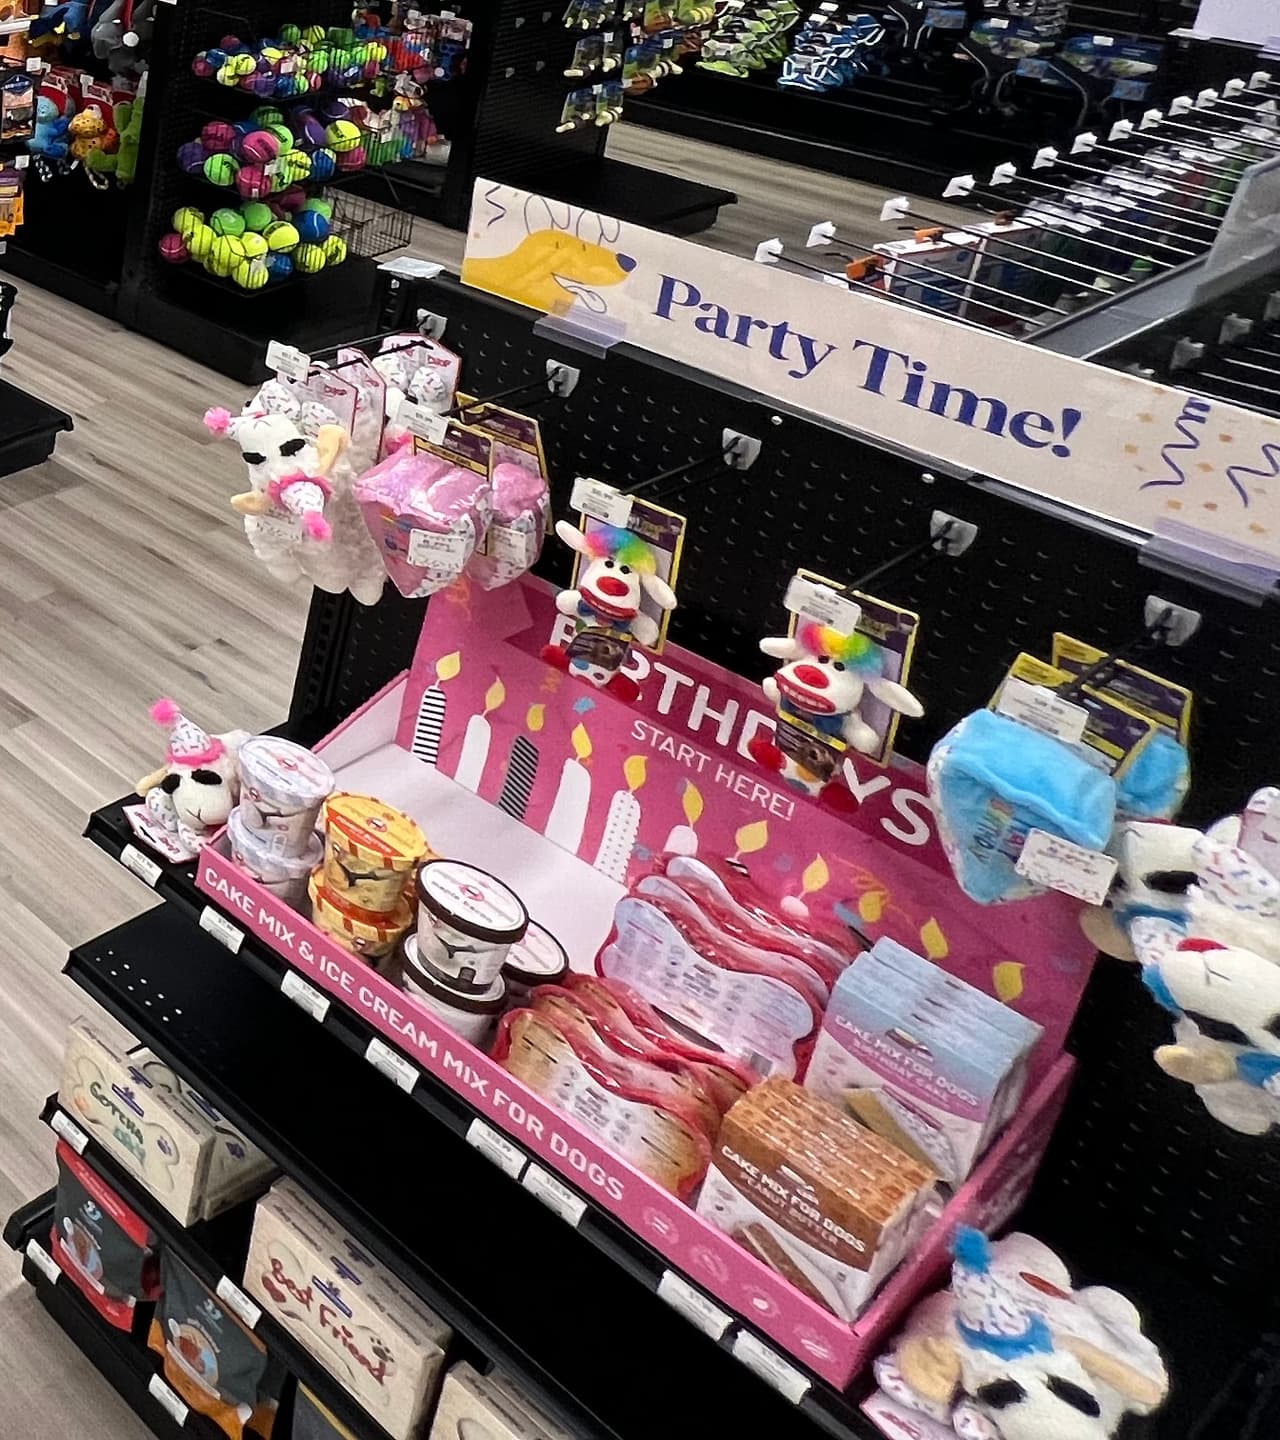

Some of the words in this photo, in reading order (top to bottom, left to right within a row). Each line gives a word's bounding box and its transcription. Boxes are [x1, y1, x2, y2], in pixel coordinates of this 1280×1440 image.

[654, 272, 838, 379] Party
[853, 338, 1083, 459] Time!
[549, 613, 932, 847] BRTHDYS
[631, 719, 711, 773] START
[715, 762, 796, 822] HERE!
[204, 867, 255, 917] CAKE
[258, 908, 296, 950] MIX
[298, 940, 315, 965] &
[319, 956, 354, 994] ICE
[358, 986, 438, 1058] CREAM
[443, 1050, 488, 1098] MIX
[492, 1088, 544, 1141] FOR
[549, 1132, 625, 1201] DOGS
[834, 1015, 873, 1047] CAKE
[876, 1039, 901, 1061] MIX
[904, 1053, 933, 1081] FOR
[935, 1076, 979, 1107] DOGS
[721, 1145, 760, 1179] CAKE
[761, 1173, 789, 1200] MIX
[791, 1196, 821, 1222] FOR
[823, 1217, 866, 1253] DOGS
